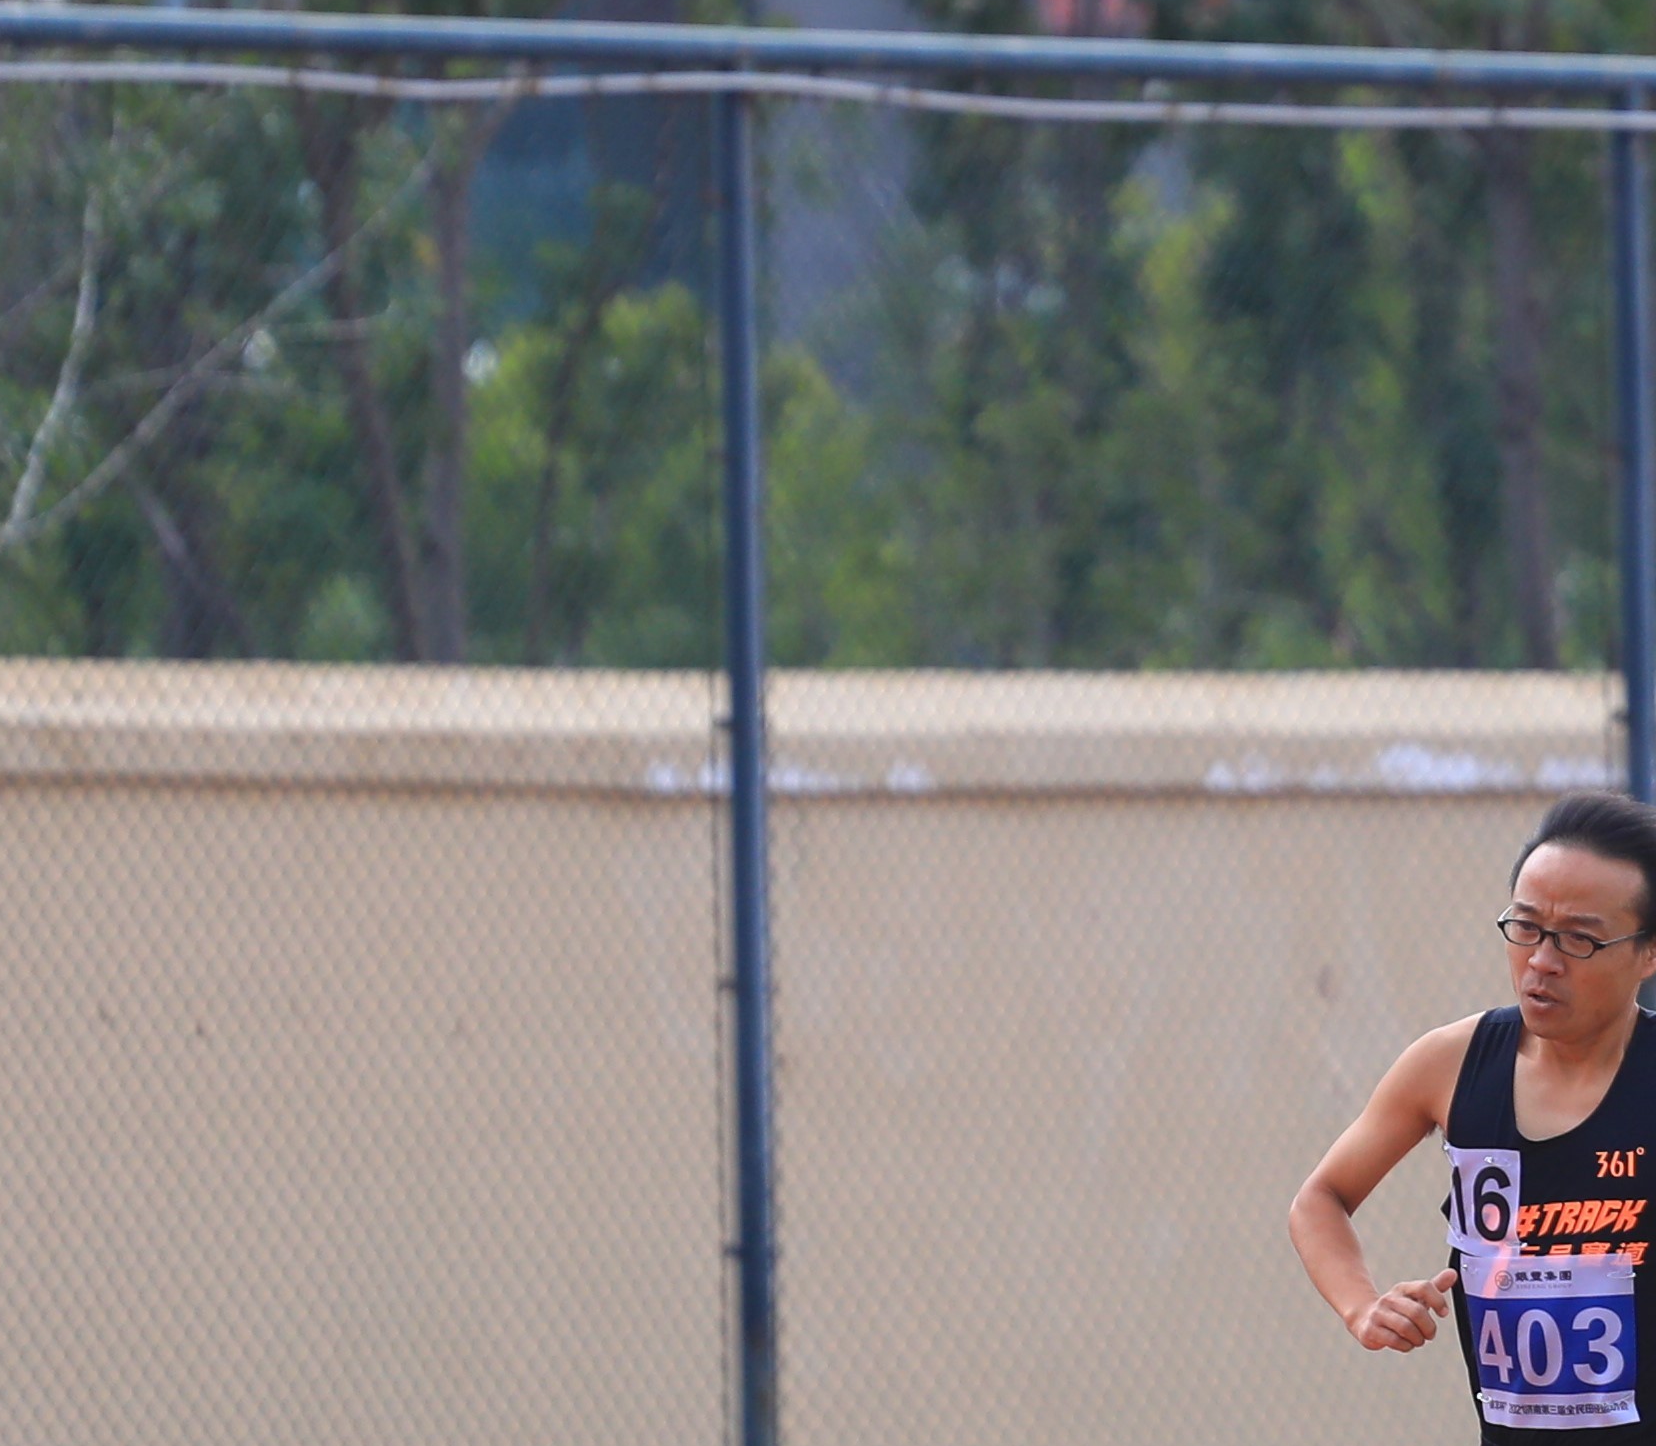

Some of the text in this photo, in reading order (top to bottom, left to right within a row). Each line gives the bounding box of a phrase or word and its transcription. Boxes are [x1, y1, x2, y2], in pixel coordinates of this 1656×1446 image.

[1595, 1147, 1645, 1178] 361°
[1452, 1166, 1512, 1242] 16
[1478, 1306, 1625, 1387] 403
